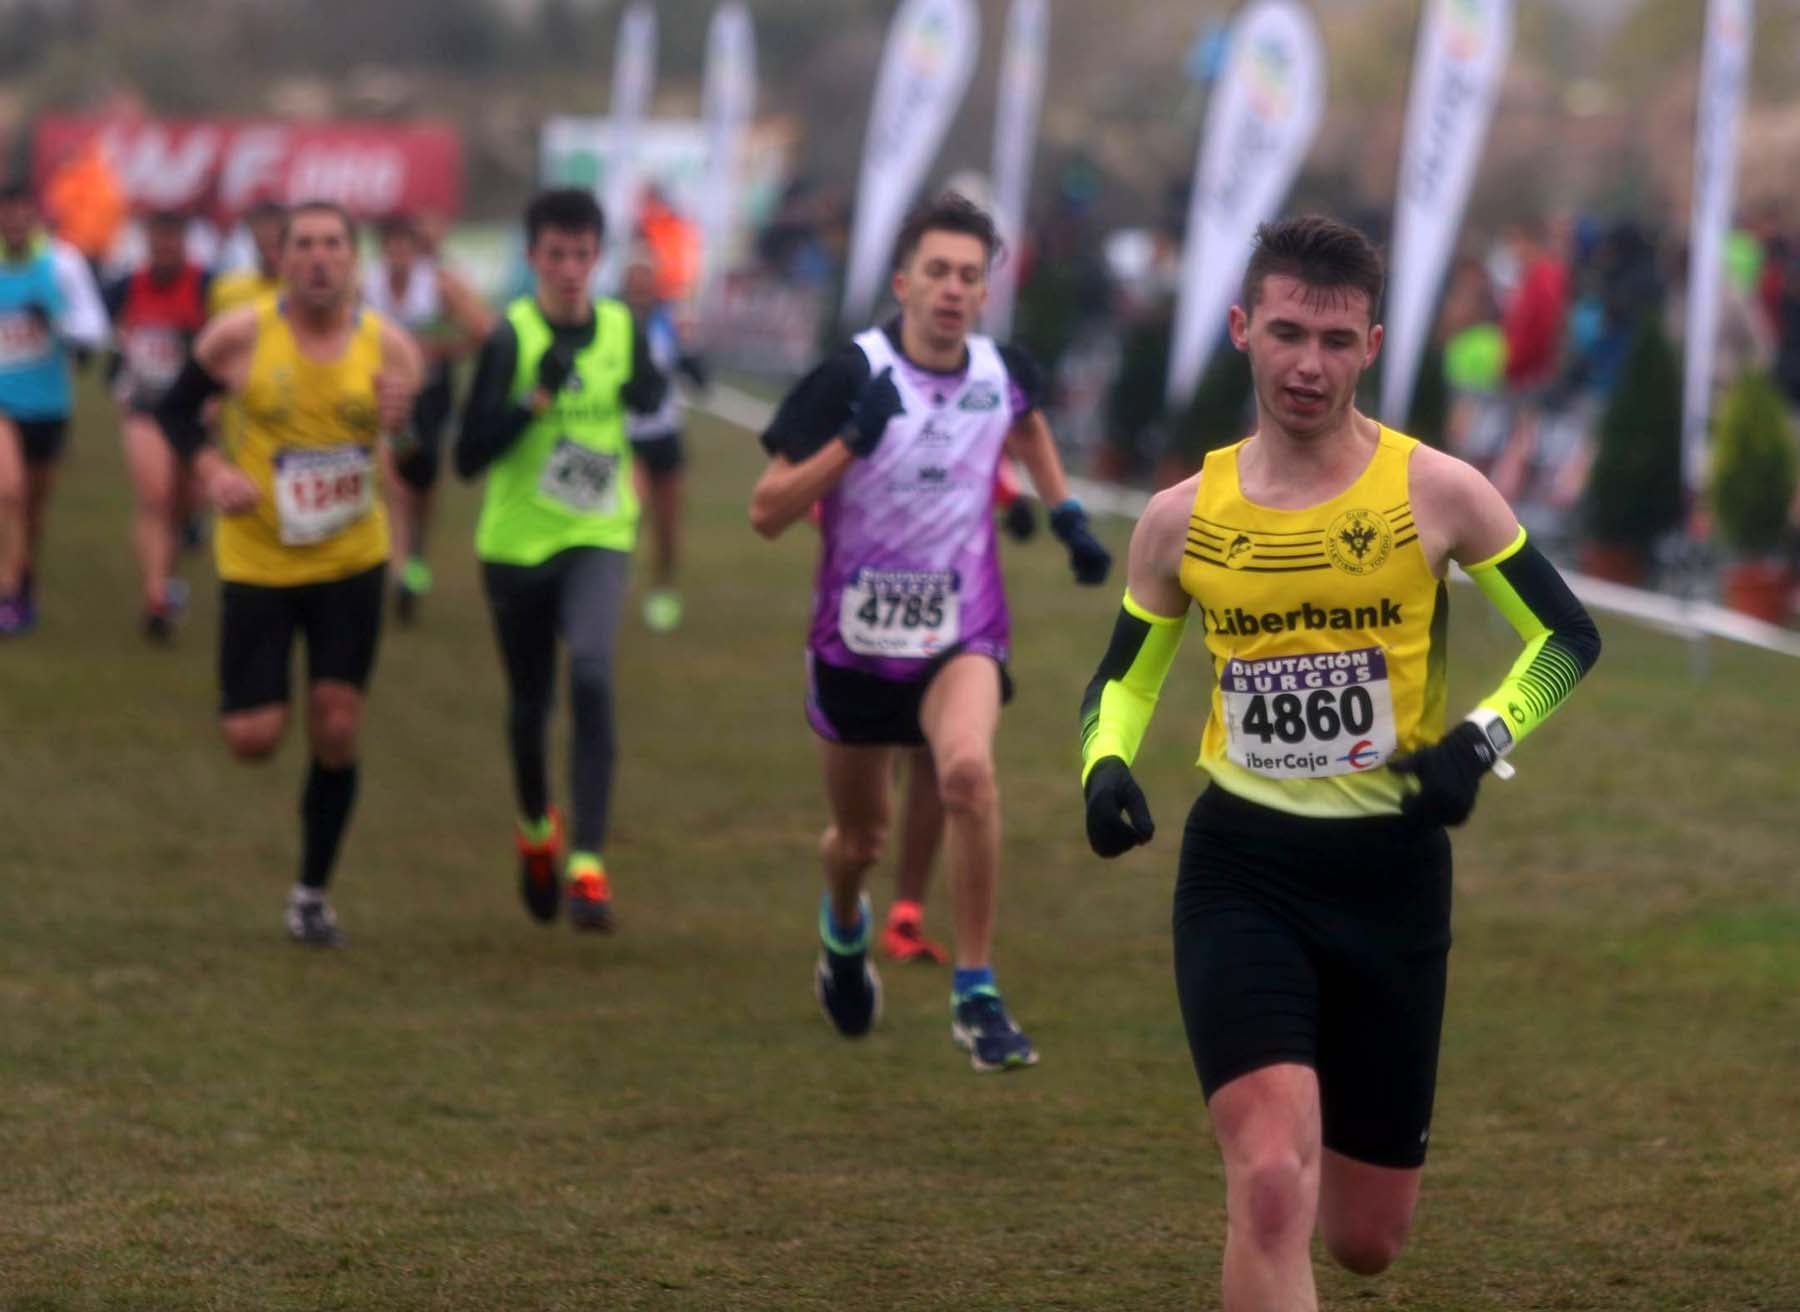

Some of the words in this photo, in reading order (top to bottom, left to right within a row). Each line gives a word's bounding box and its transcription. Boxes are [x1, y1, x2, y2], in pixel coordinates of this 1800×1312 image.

[857, 587, 943, 629] 4785
[1208, 599, 1403, 636] Liberbank
[1231, 651, 1369, 677] DIPUTACIÓN
[1232, 666, 1371, 692] BURGOS
[1242, 685, 1374, 744] 4860
[1246, 752, 1329, 772] iberCaja
